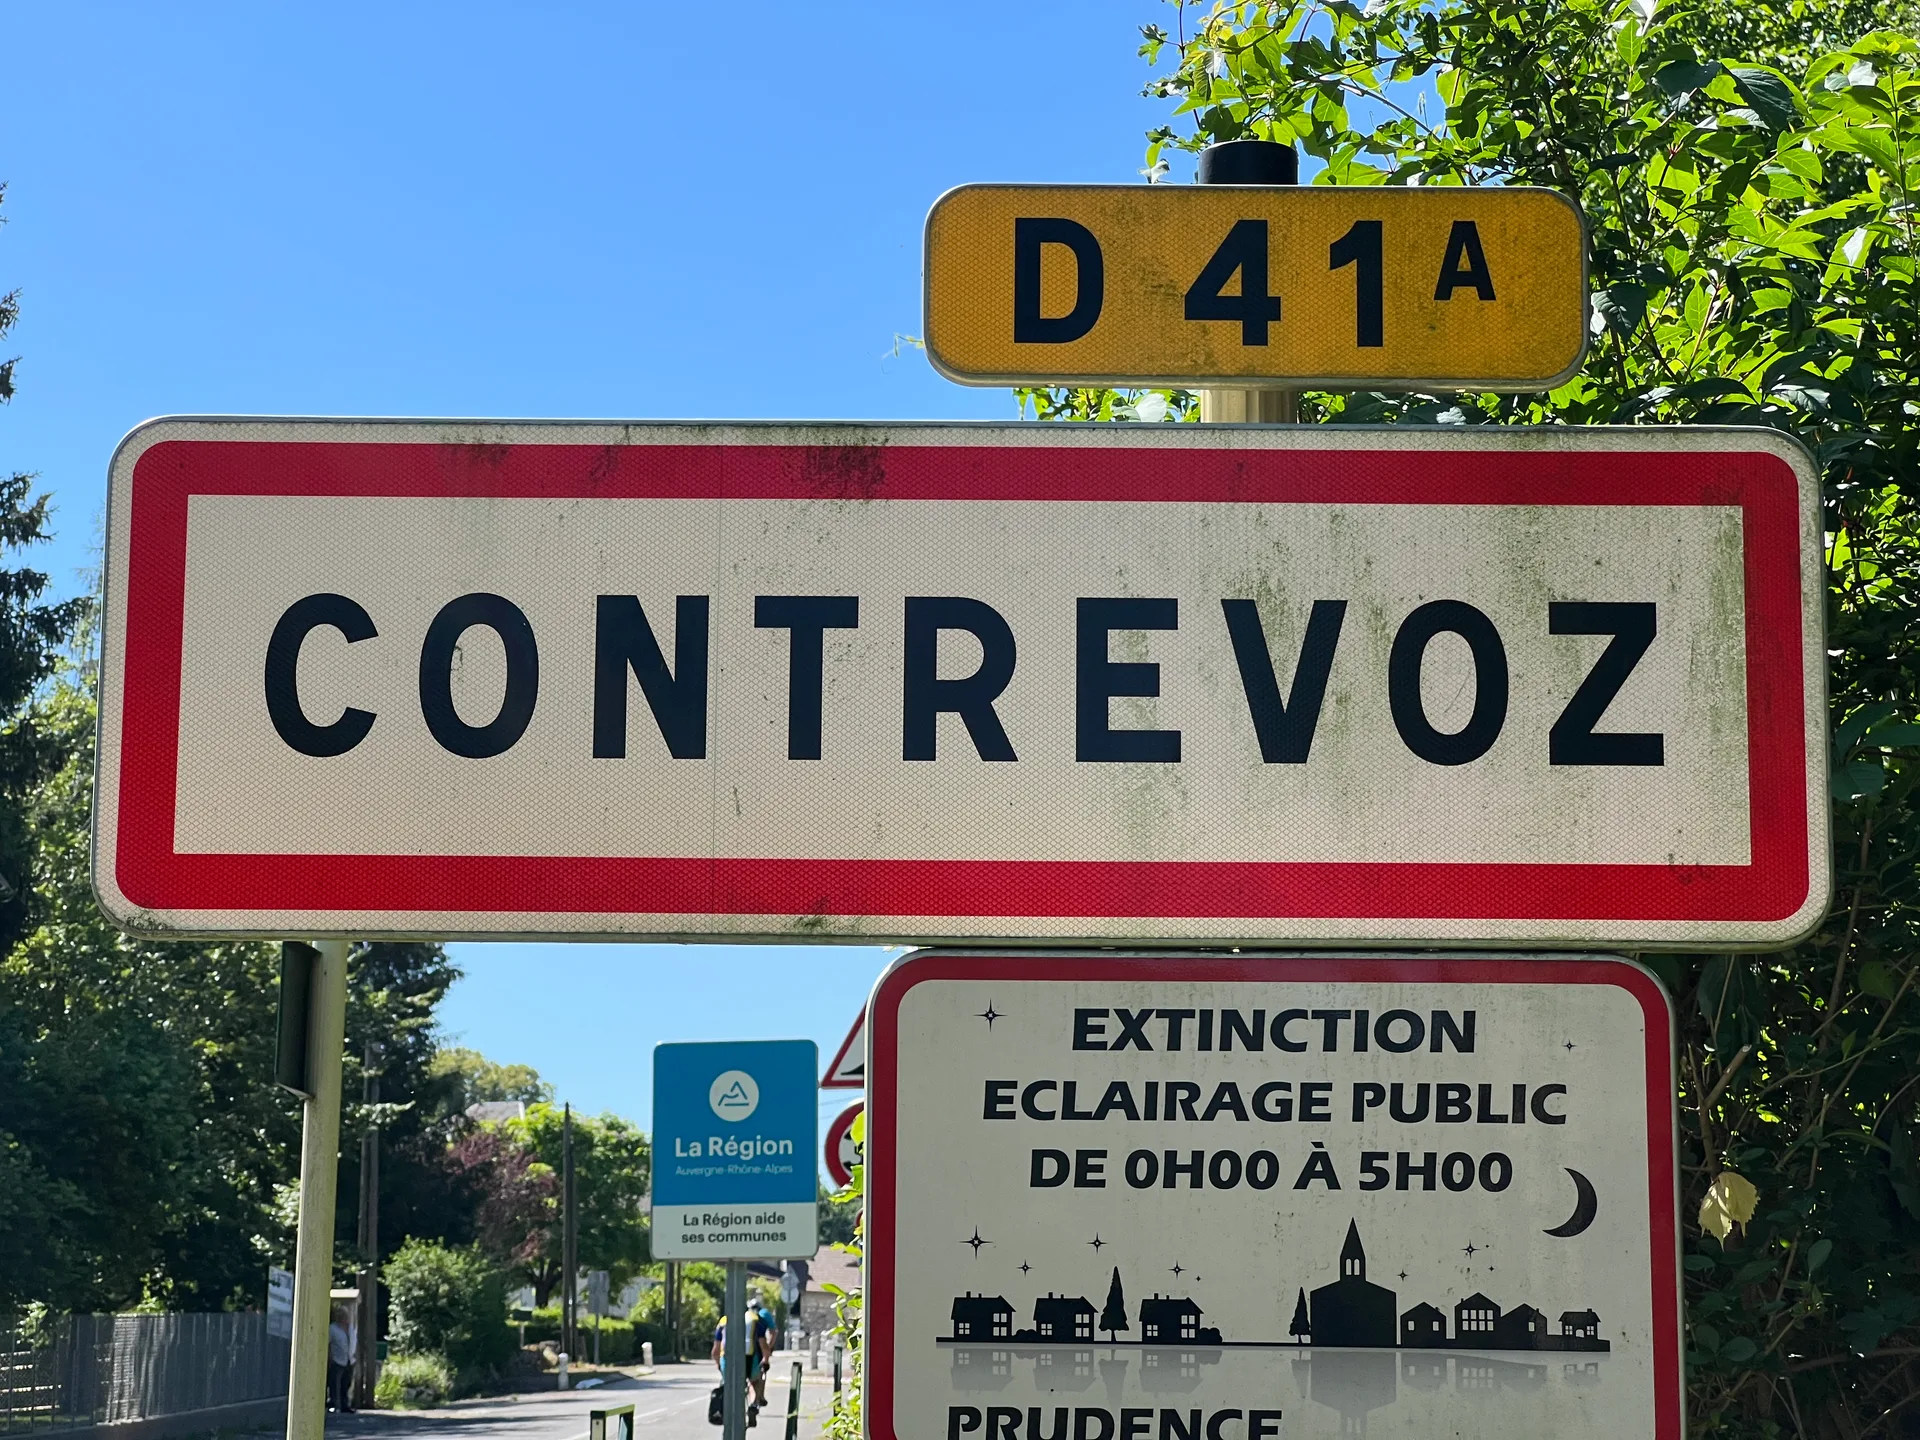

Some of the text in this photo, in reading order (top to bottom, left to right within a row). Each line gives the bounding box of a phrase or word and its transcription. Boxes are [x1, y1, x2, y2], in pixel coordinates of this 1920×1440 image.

[1014, 218, 1104, 344] D
[264, 592, 1666, 767] CONTREVOZ
[1072, 1007, 1477, 1054] EXTINCTION
[983, 1079, 1567, 1125] ECLAIRAGE PUBLIC
[674, 1135, 793, 1160] La Région
[1029, 1141, 1514, 1193] DE 0H00 À 5H00
[675, 1164, 793, 1177] Auvergne-Rhône-Alpes
[681, 1230, 787, 1244] ses communes
[683, 1211, 786, 1229] La Région aide
[948, 1406, 1283, 1440] PRUDENCE
